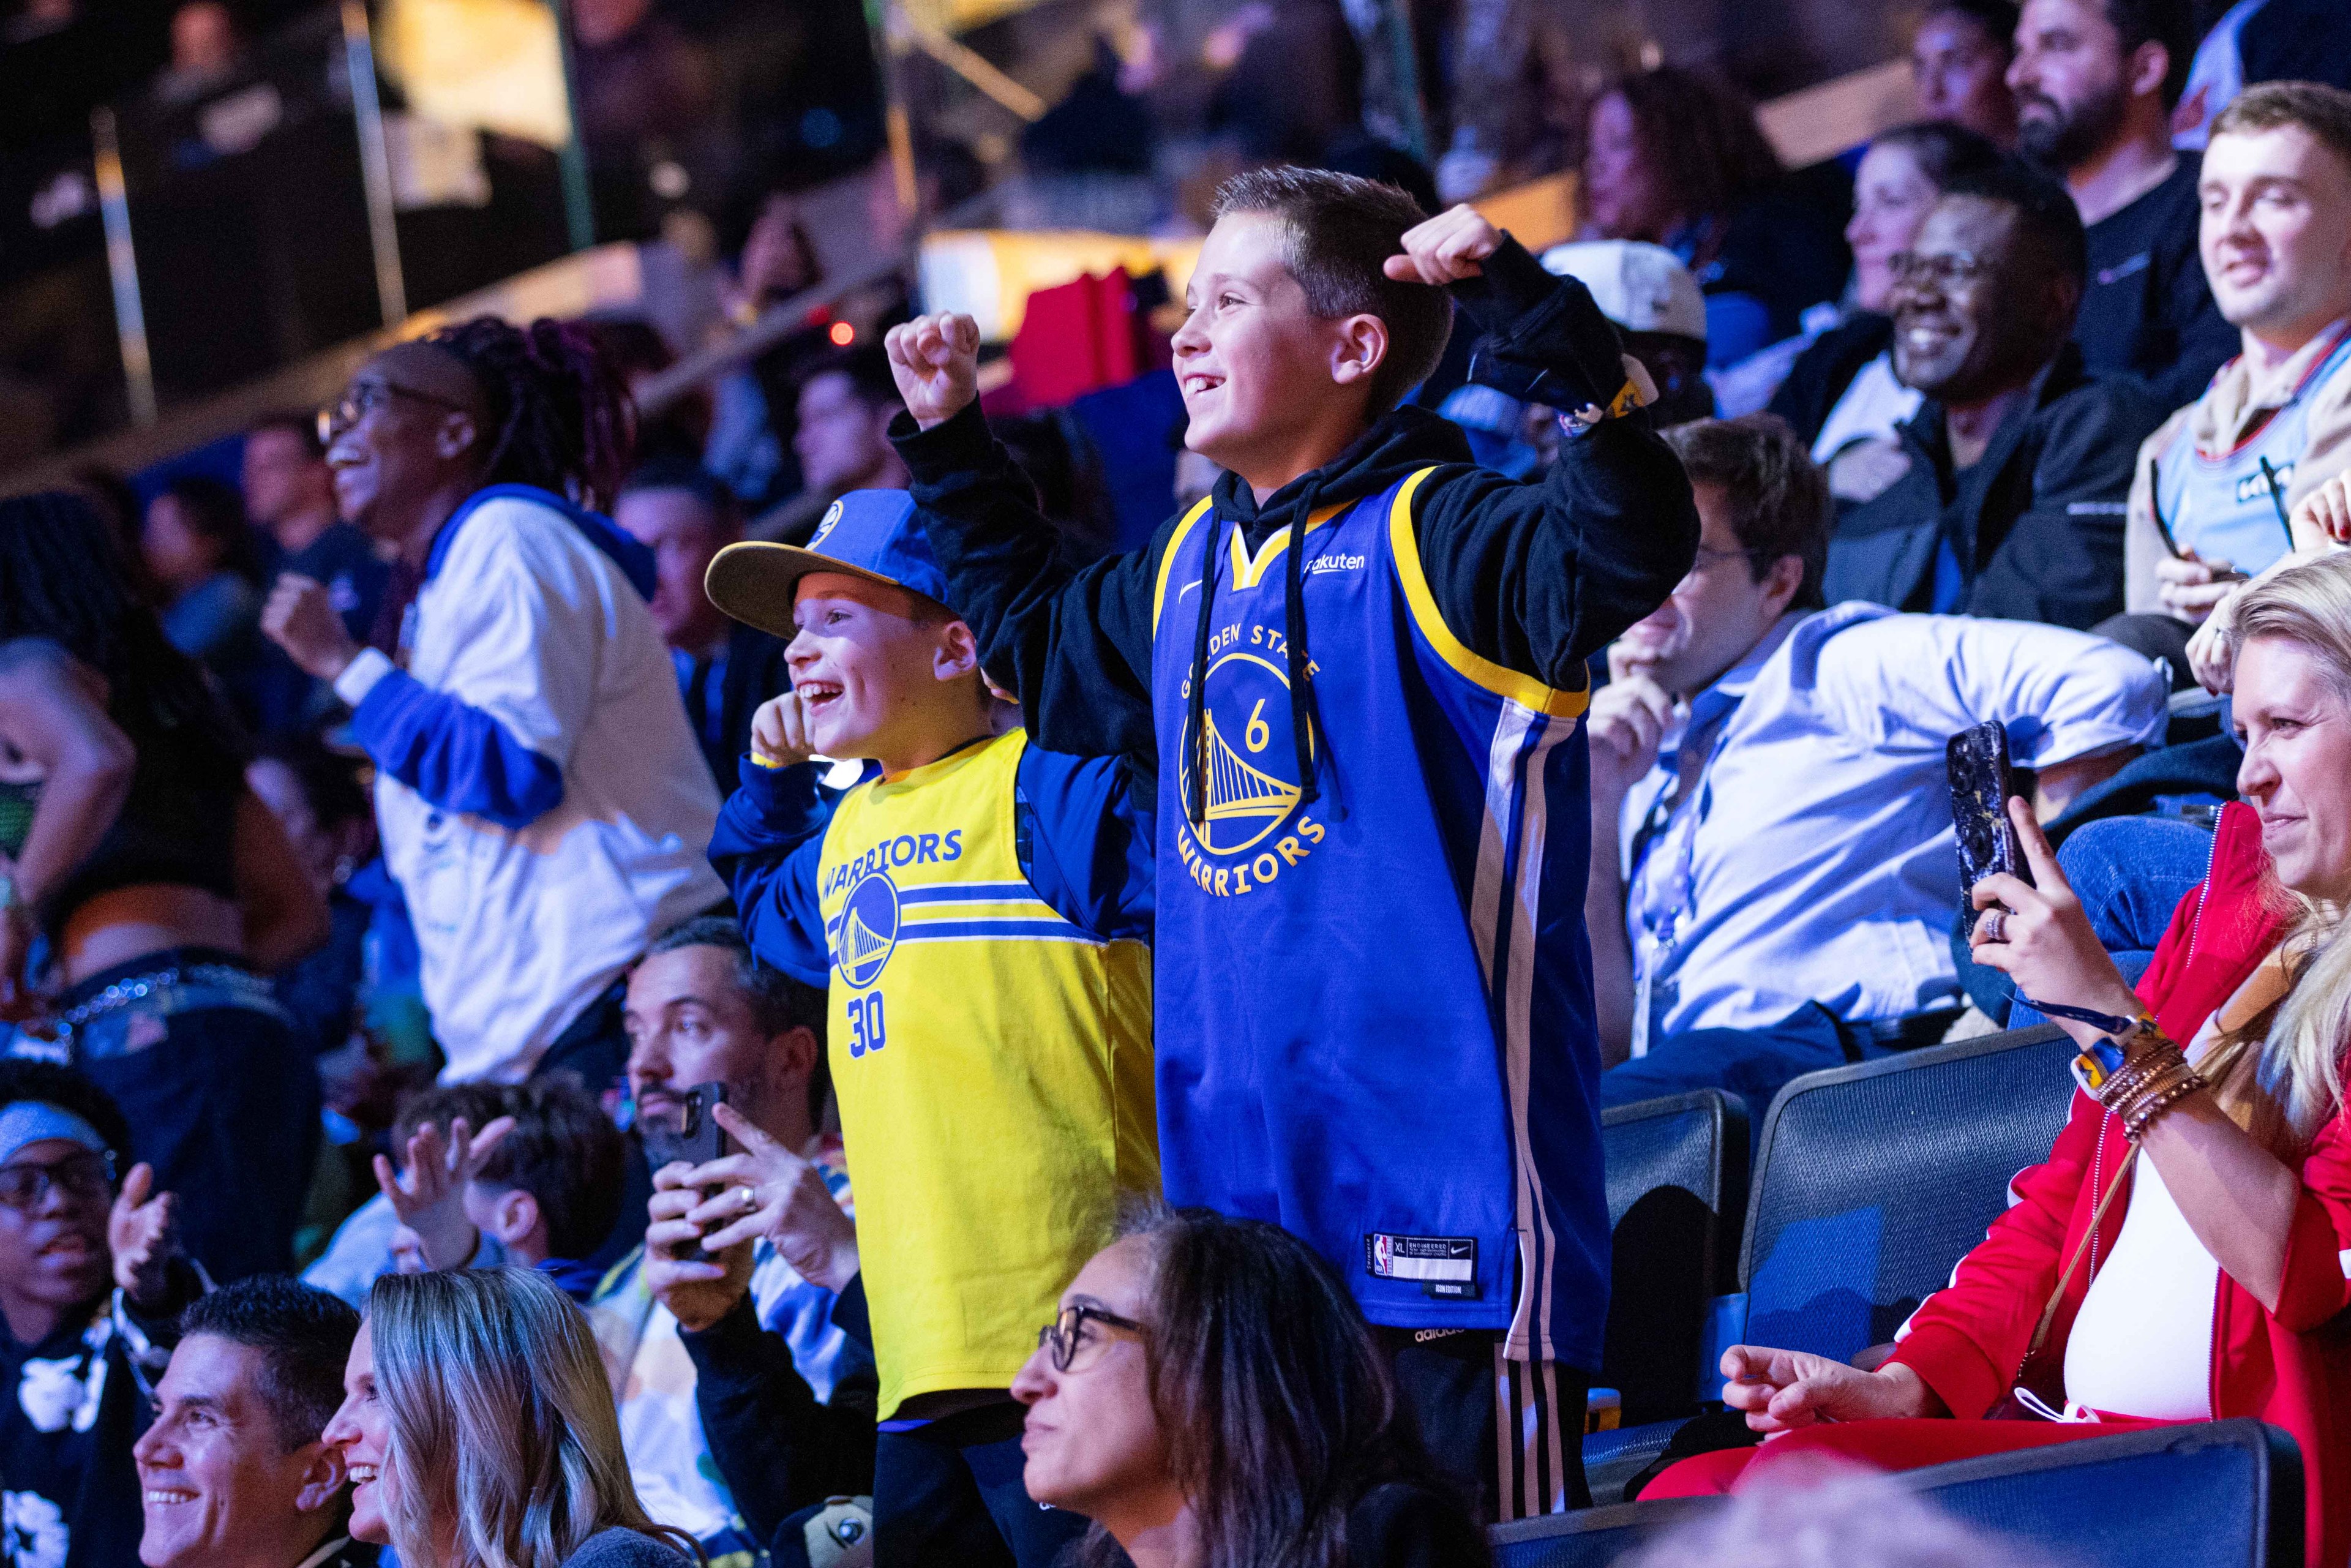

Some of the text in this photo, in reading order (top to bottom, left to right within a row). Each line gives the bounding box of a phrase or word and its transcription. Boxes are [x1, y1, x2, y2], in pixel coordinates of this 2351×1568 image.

[1181, 623, 1320, 699] GDEN STAE
[1245, 699, 1270, 752] 6
[822, 830, 962, 902] WARRIORS
[1178, 815, 1325, 896] WARRIORS
[847, 990, 886, 1059] 30
[1395, 1242, 1404, 1253] XL
